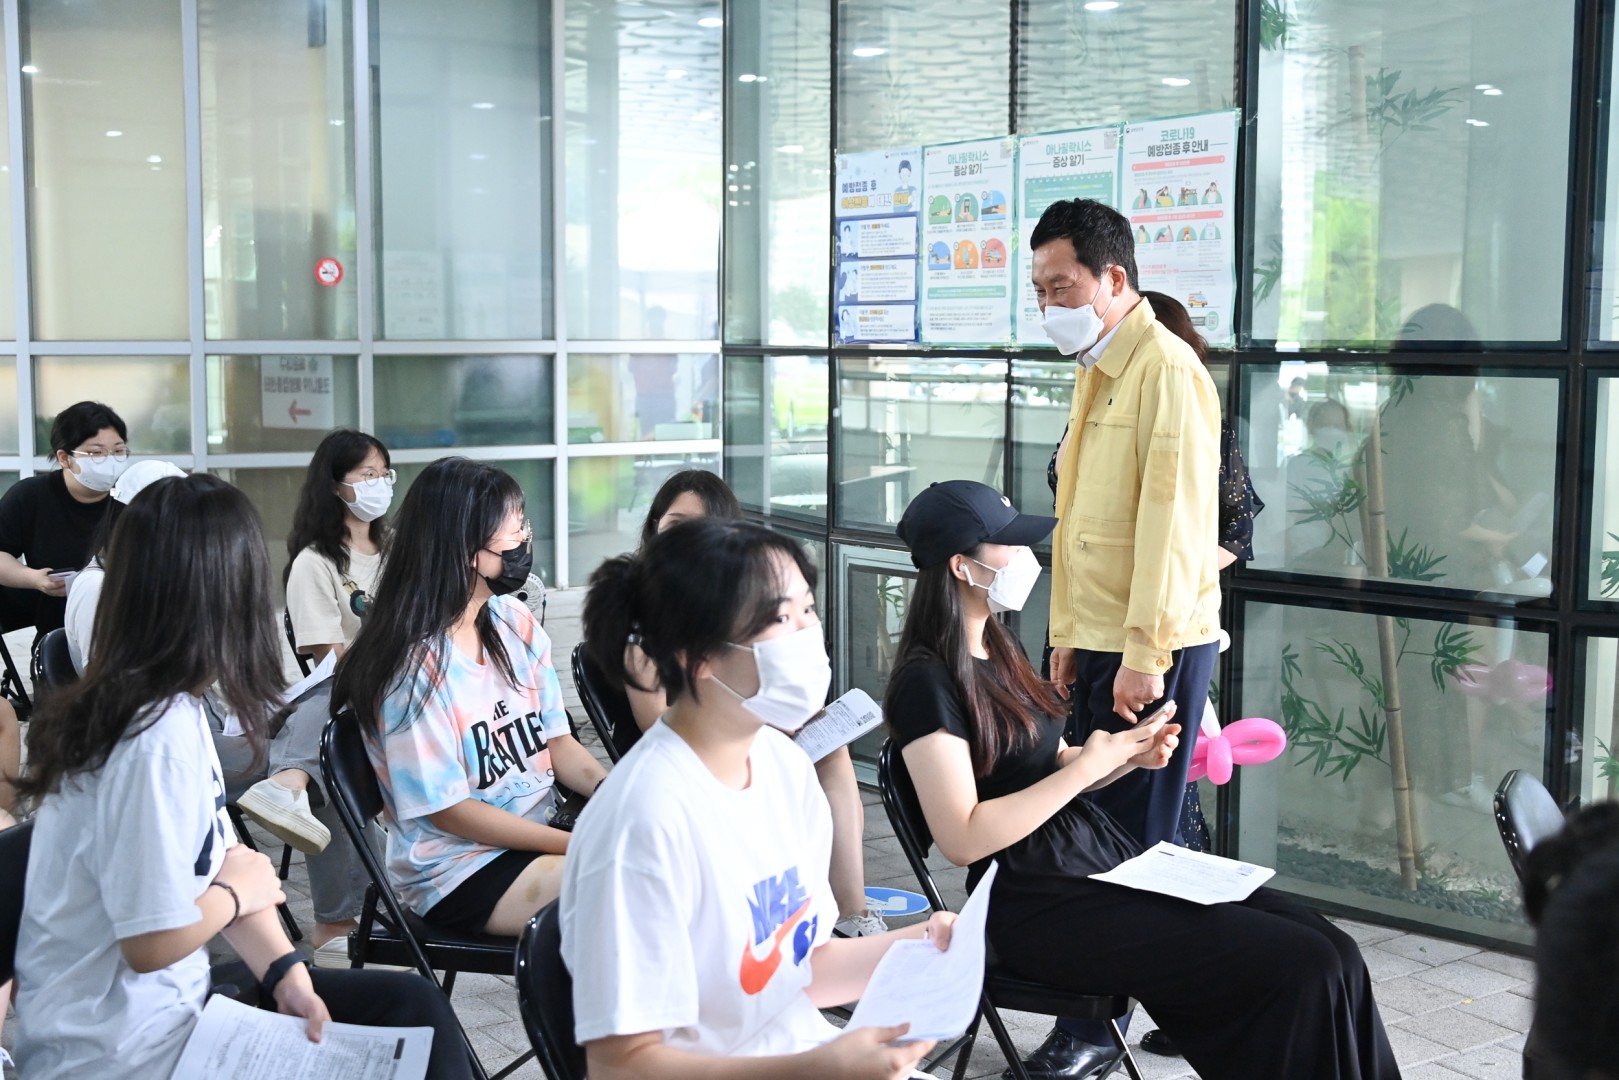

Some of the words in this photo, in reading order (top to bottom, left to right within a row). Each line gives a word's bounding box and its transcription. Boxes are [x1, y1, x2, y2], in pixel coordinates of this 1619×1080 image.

[1160, 127, 1195, 142] 코로나19
[1045, 141, 1092, 155] 아나필락시스
[1147, 142, 1181, 157] 예방접종
[1182, 141, 1191, 154] 후
[1191, 139, 1209, 153] 안내
[947, 150, 989, 165] 아나필락시스
[1053, 156, 1067, 168] 증상
[1069, 154, 1085, 166] 알기
[954, 165, 968, 177] 증상
[968, 163, 982, 175] 알기
[842, 181, 868, 193] 예방접종
[493, 700, 510, 721] HE
[470, 710, 548, 790] BEATLE
[745, 865, 811, 946] NIKE
